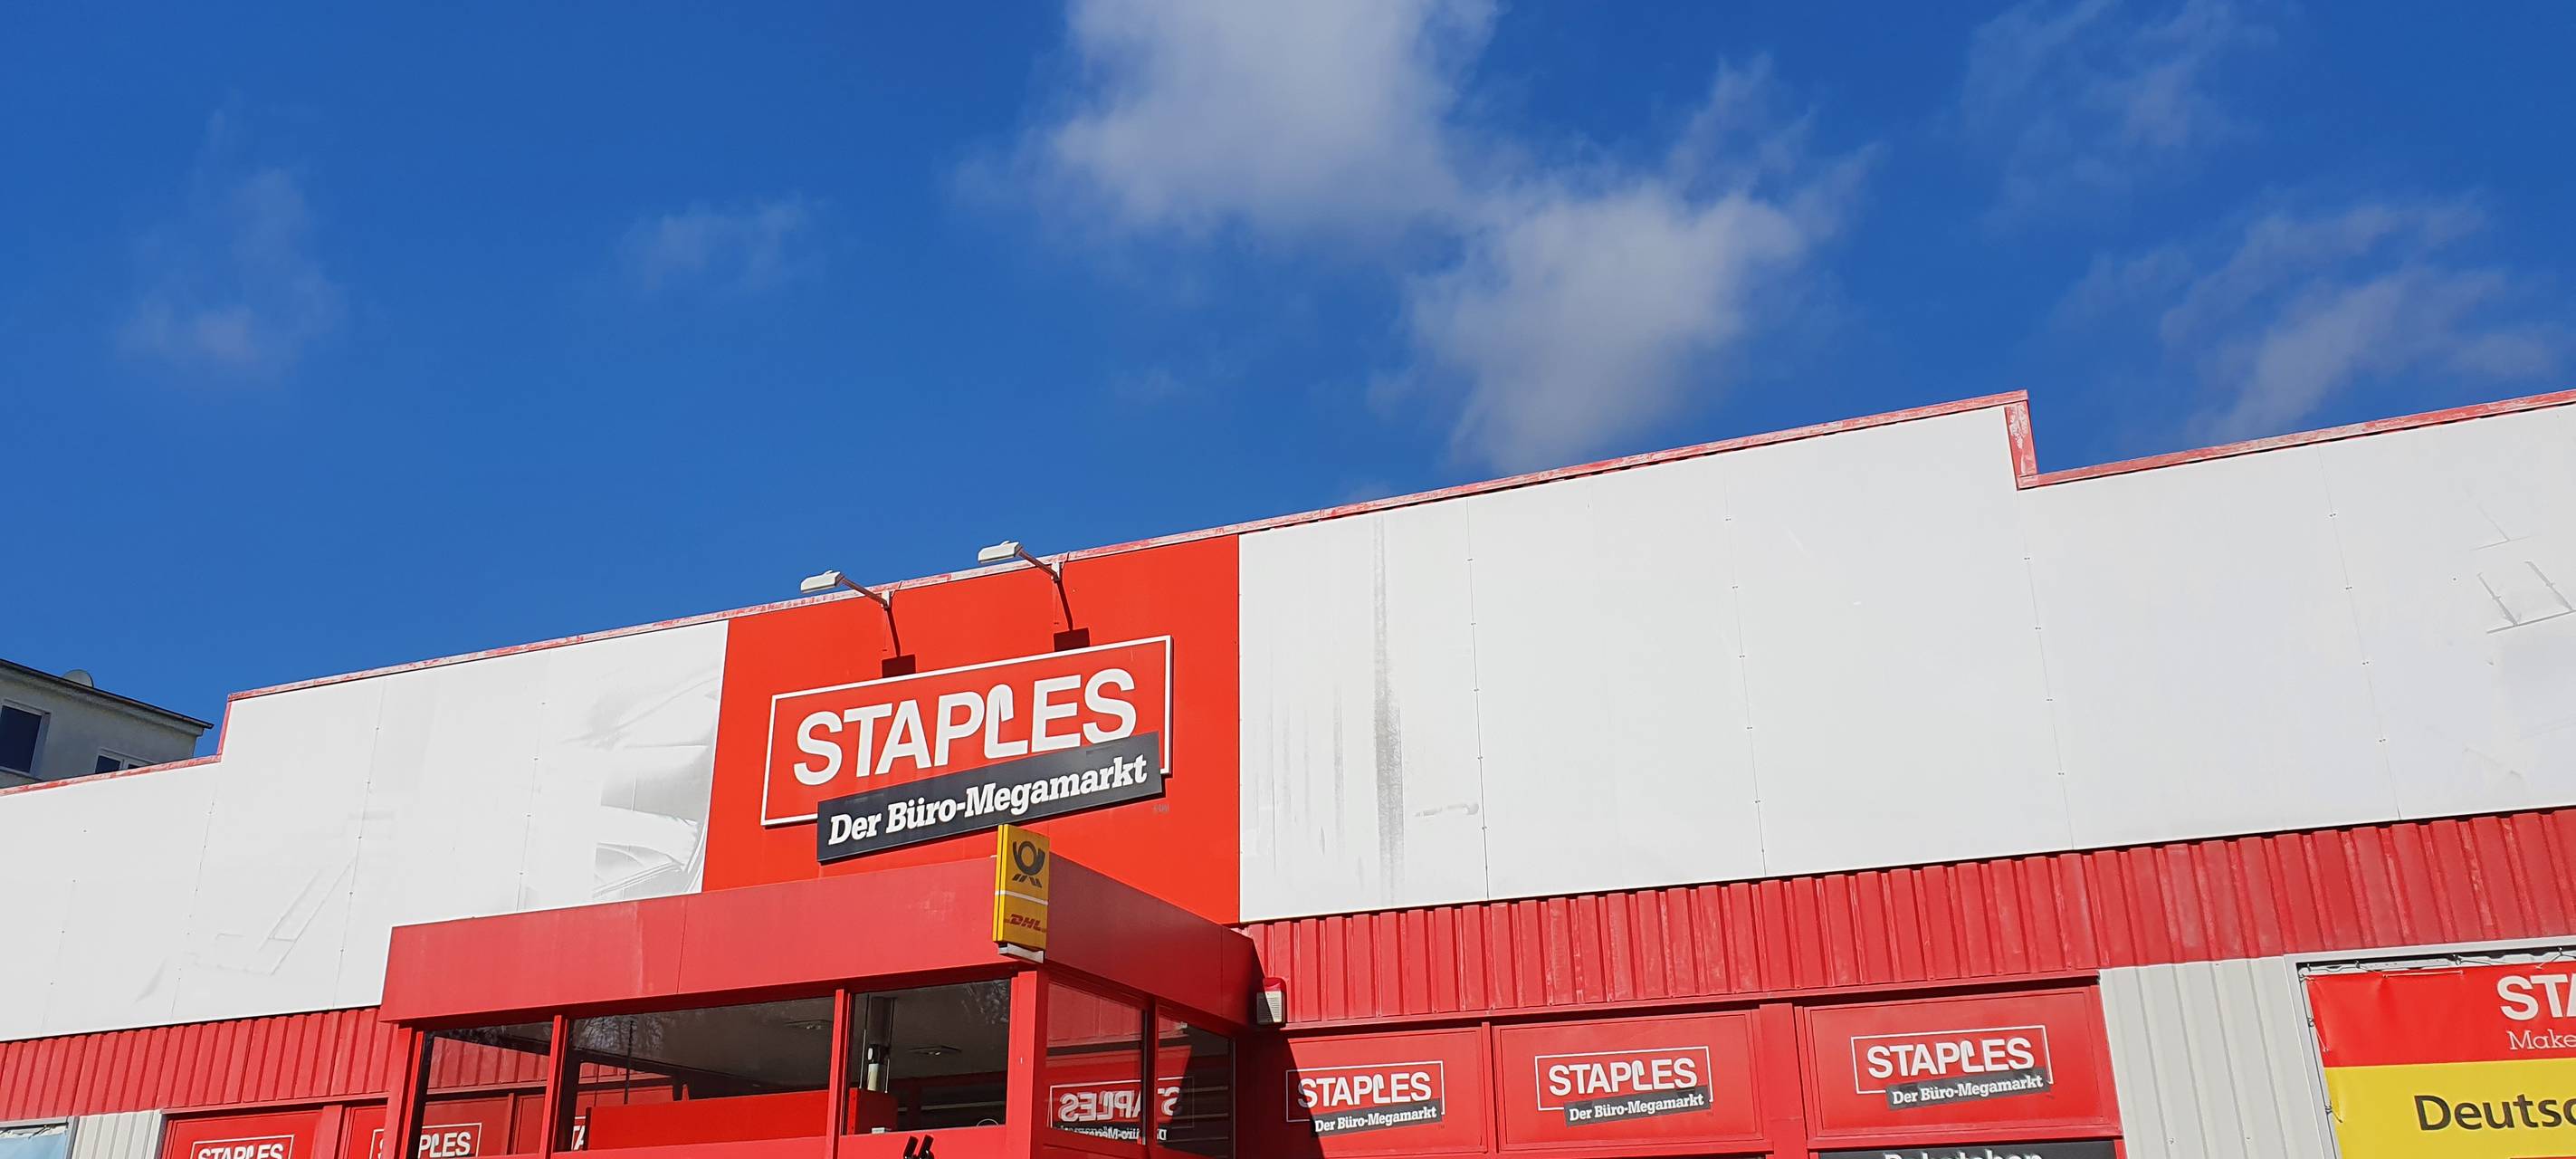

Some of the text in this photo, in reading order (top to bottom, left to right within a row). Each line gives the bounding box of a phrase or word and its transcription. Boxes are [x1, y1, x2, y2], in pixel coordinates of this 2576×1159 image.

[794, 668, 1137, 786] STAPLES
[827, 753, 1148, 846] Der Büro-Megamarkt
[1009, 914, 1043, 932] DHL
[2496, 973, 2576, 1021] ST
[1866, 1037, 2035, 1079] STAPLES
[1297, 1071, 1432, 1108] STAPLES
[1549, 1058, 1698, 1097] STAPLES
[1893, 1075, 2044, 1105] Der Büro-Megamarkt
[1315, 1106, 1437, 1132] Der Büro-Megamarkt
[1569, 1093, 1704, 1121] Der Büro-Megamarkt
